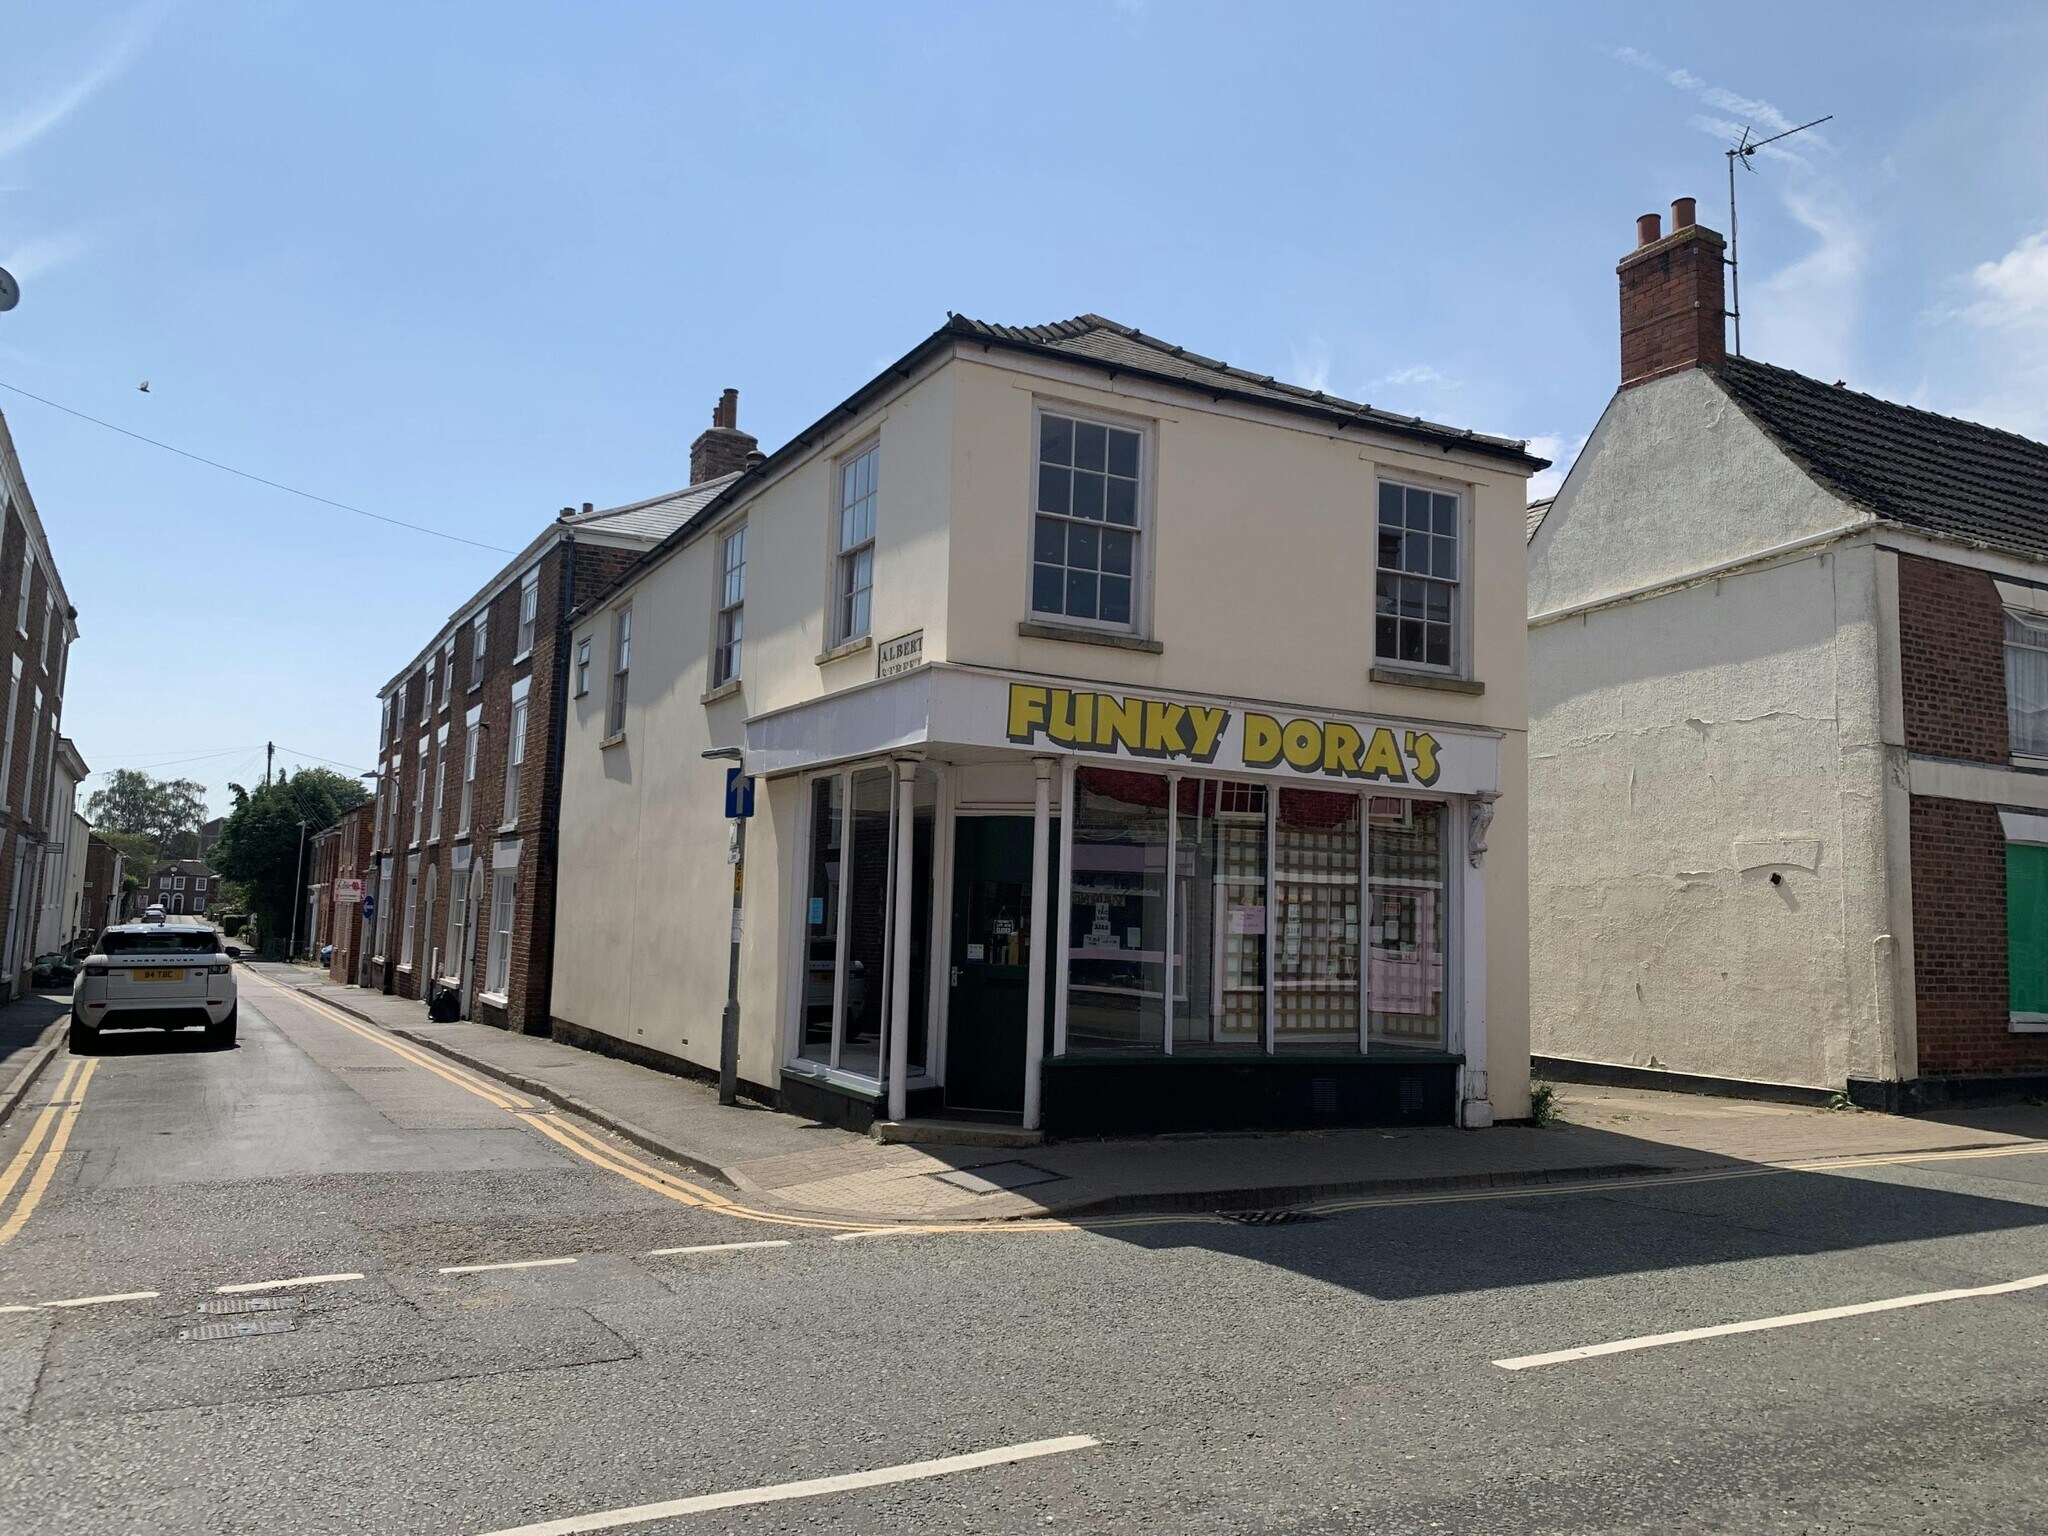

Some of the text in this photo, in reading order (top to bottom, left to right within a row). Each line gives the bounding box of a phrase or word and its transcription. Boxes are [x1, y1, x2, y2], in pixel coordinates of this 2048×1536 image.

[881, 636, 923, 664] ALBERT
[1006, 682, 1441, 788] FUNKY DORA'S
